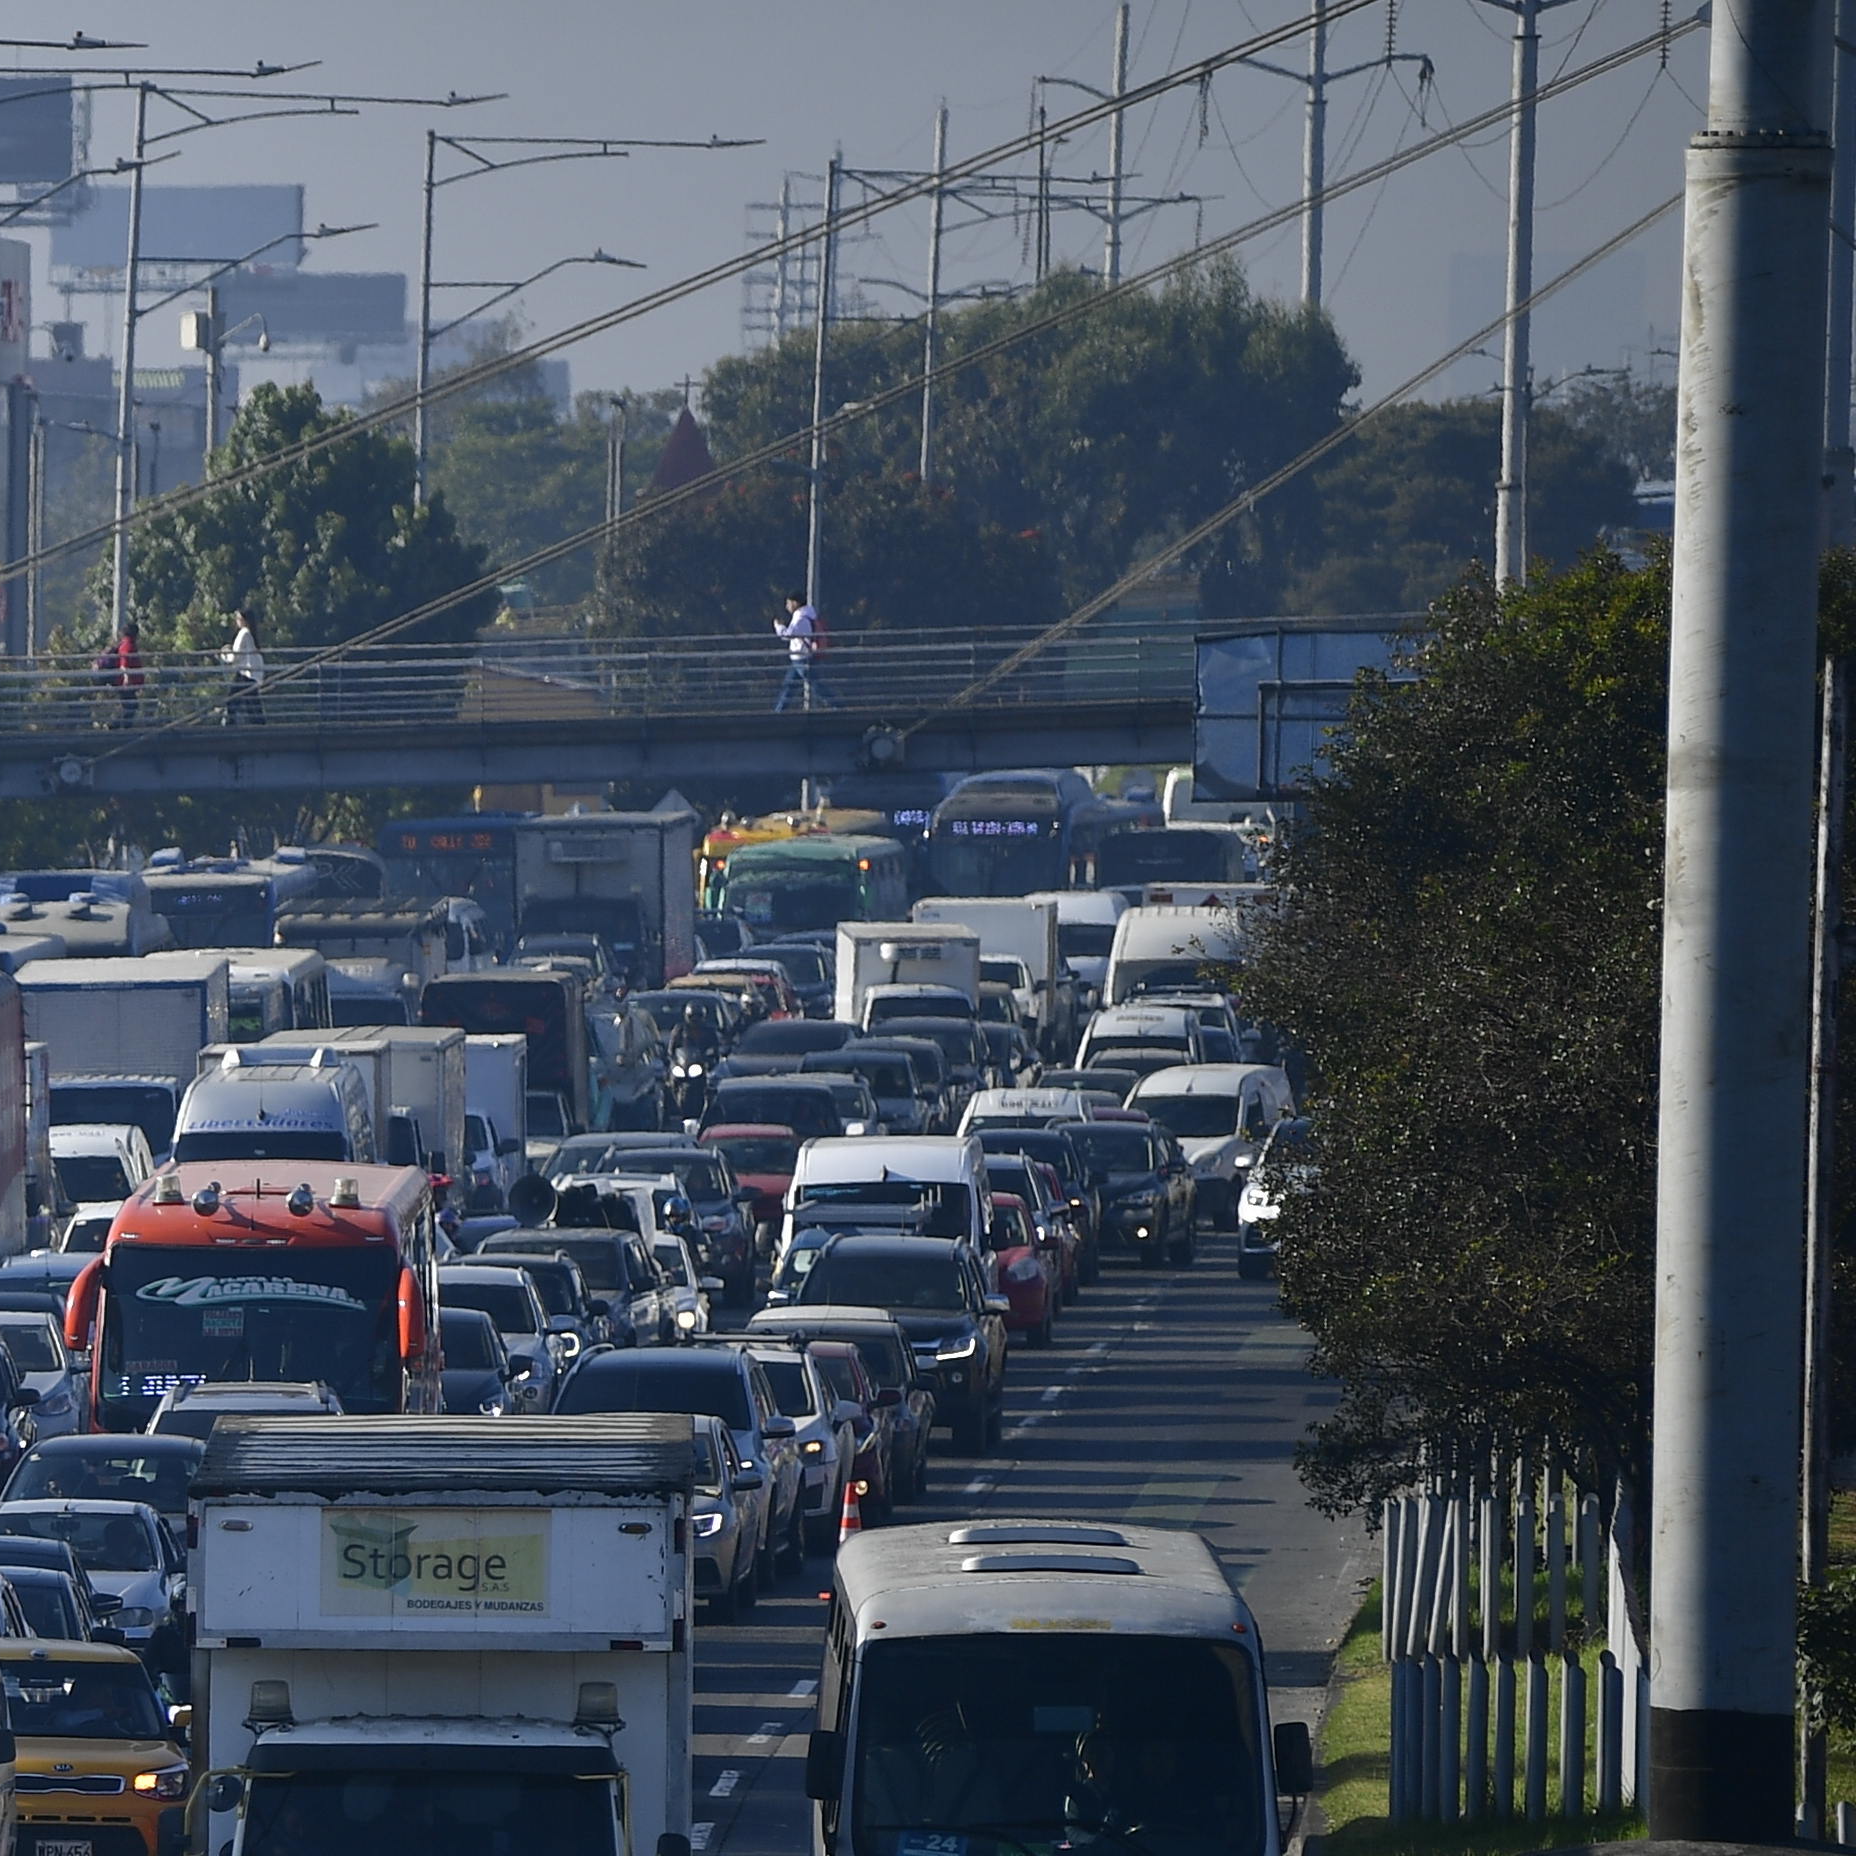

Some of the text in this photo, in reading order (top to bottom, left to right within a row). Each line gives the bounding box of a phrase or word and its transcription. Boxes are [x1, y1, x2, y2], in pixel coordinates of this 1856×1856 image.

[136, 1277, 350, 1306] MACARENA
[343, 1543, 506, 1592] Storage
[407, 1599, 544, 1612] BODEGAJES Y MUDANZAS
[926, 1833, 958, 1852] 24
